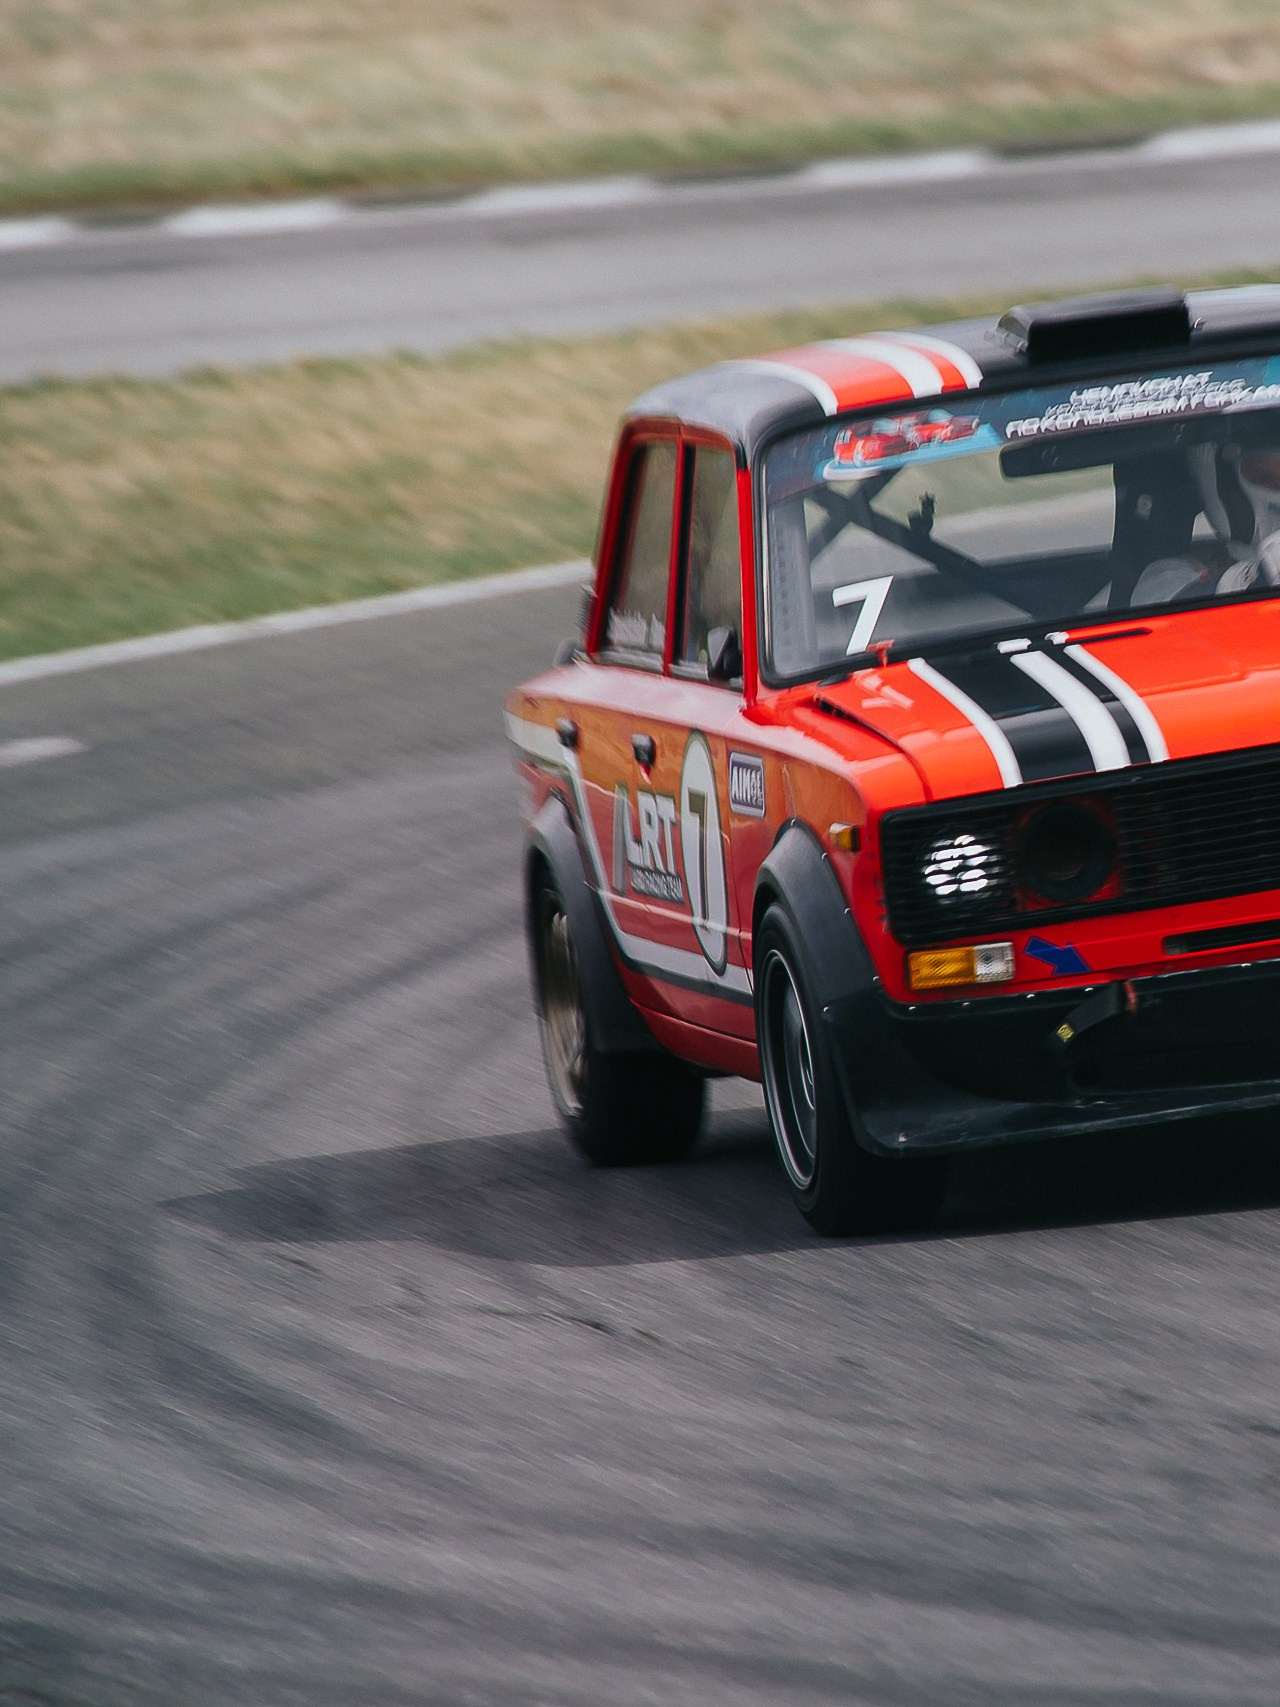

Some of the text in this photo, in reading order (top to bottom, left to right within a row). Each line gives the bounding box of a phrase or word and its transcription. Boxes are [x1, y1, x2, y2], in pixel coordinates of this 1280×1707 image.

[1006, 417, 1041, 438] ПО
[832, 575, 893, 656] 7
[622, 784, 677, 877] LRT
[687, 787, 709, 930] 7
